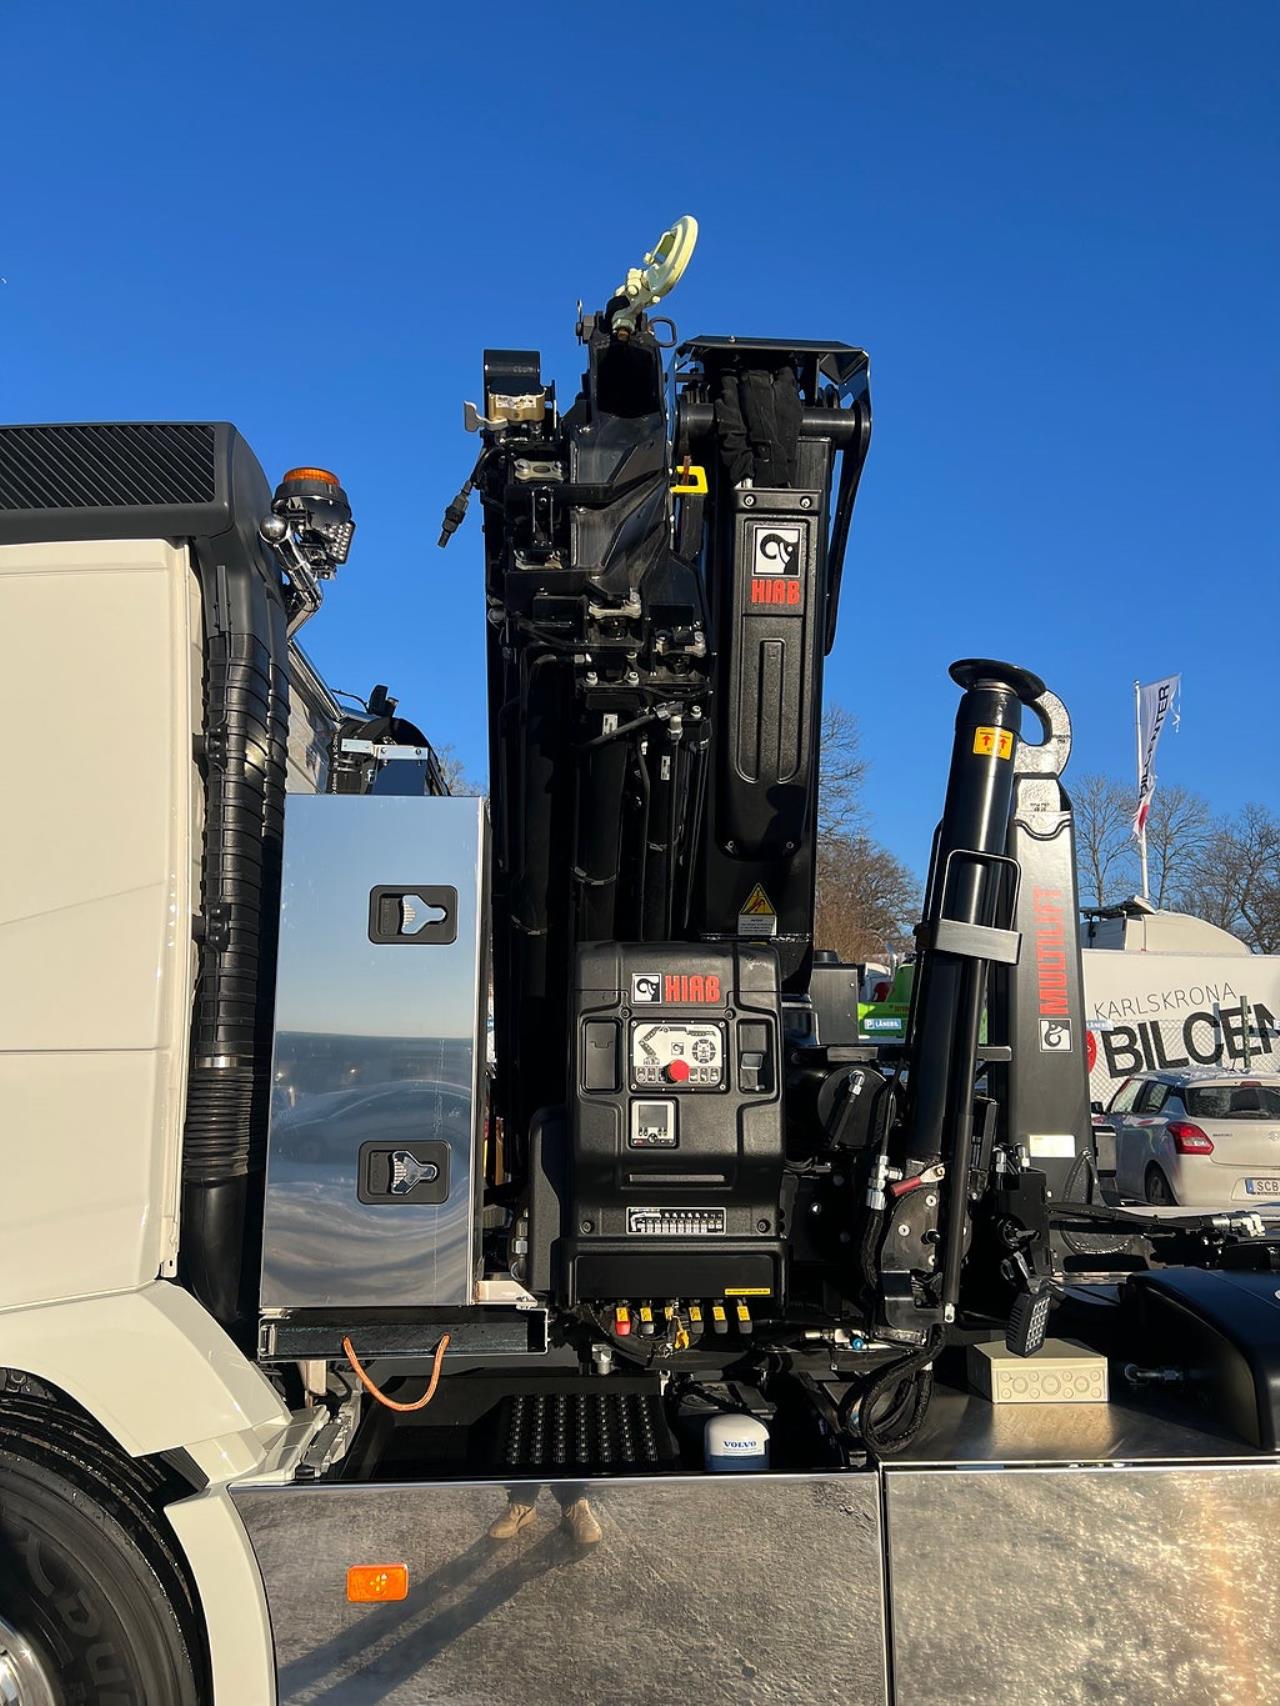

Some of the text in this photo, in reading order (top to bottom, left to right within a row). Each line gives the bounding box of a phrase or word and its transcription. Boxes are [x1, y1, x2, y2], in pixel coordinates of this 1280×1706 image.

[751, 579, 800, 605] HIAB
[1033, 886, 1069, 1015] MULTILIFT
[665, 975, 720, 1002] HIAB
[1094, 982, 1237, 1020] KARLSKRONA
[1256, 1181, 1279, 1192] SCB
[724, 1440, 757, 1448] VOLVO
